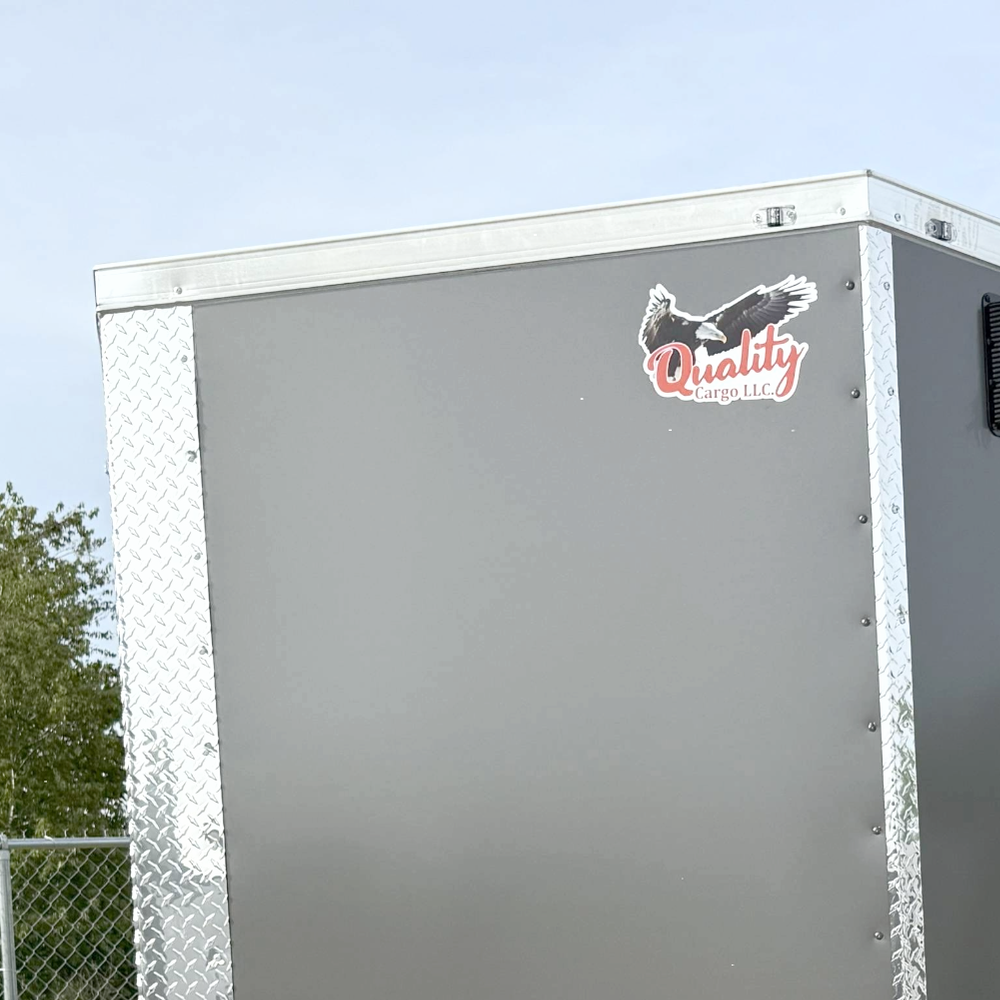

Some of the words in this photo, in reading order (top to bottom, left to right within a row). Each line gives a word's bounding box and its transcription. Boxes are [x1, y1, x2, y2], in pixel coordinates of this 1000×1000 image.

[647, 325, 805, 397] Quality
[695, 386, 739, 402] Cargo
[743, 383, 774, 397] LLC.
